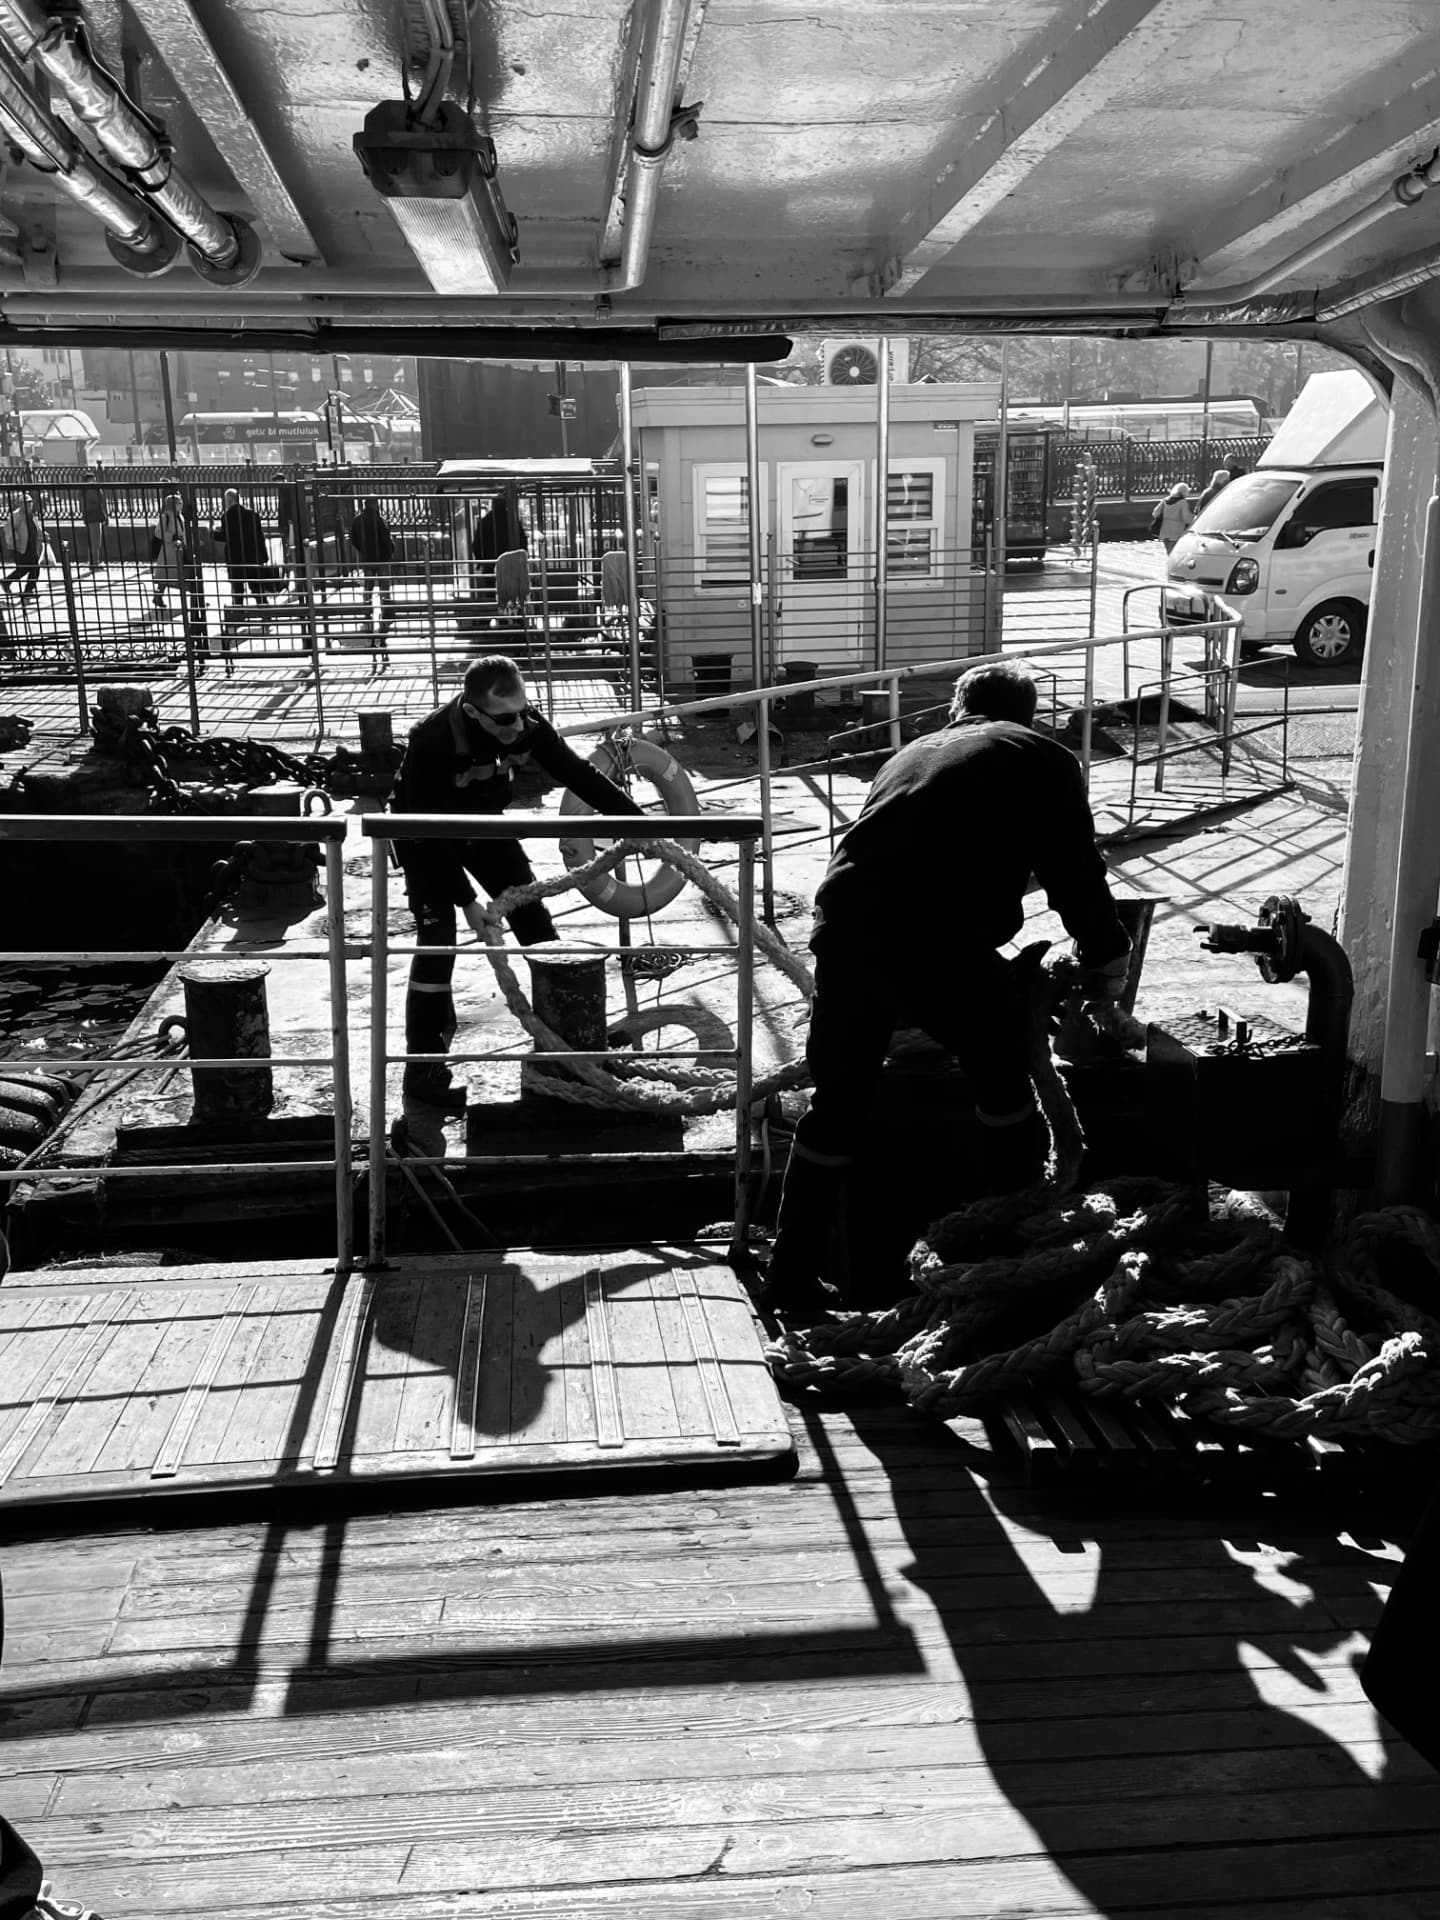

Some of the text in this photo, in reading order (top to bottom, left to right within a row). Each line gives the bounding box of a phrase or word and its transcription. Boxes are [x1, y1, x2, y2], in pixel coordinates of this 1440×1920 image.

[246, 426, 320, 438] getir bi mutluluk
